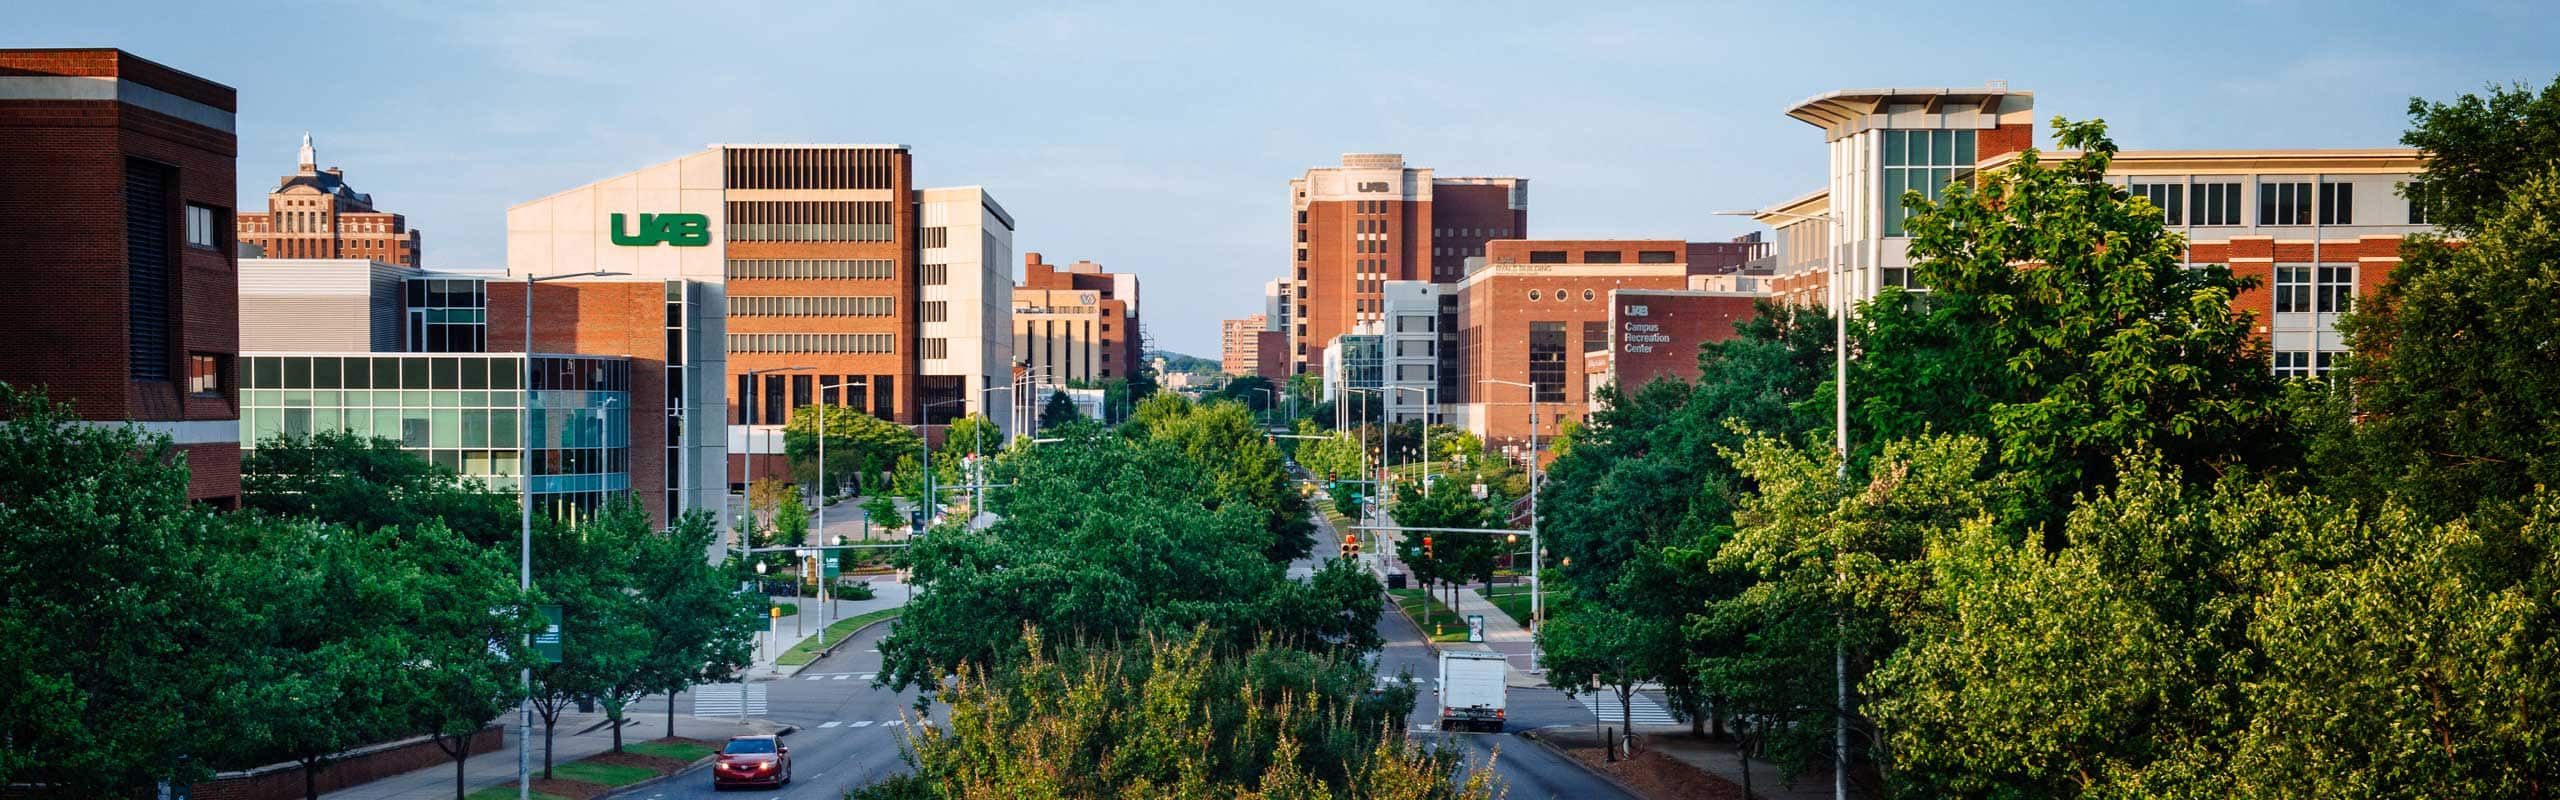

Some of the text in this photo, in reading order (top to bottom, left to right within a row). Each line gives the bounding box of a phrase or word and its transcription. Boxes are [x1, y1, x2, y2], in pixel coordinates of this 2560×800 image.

[1358, 182, 1389, 192] UAB
[611, 213, 710, 246] UAB
[1625, 305, 1648, 316] UAB
[1625, 322, 1658, 333] Campus
[1625, 333, 1669, 342] Recreation
[1625, 344, 1653, 352] Center
